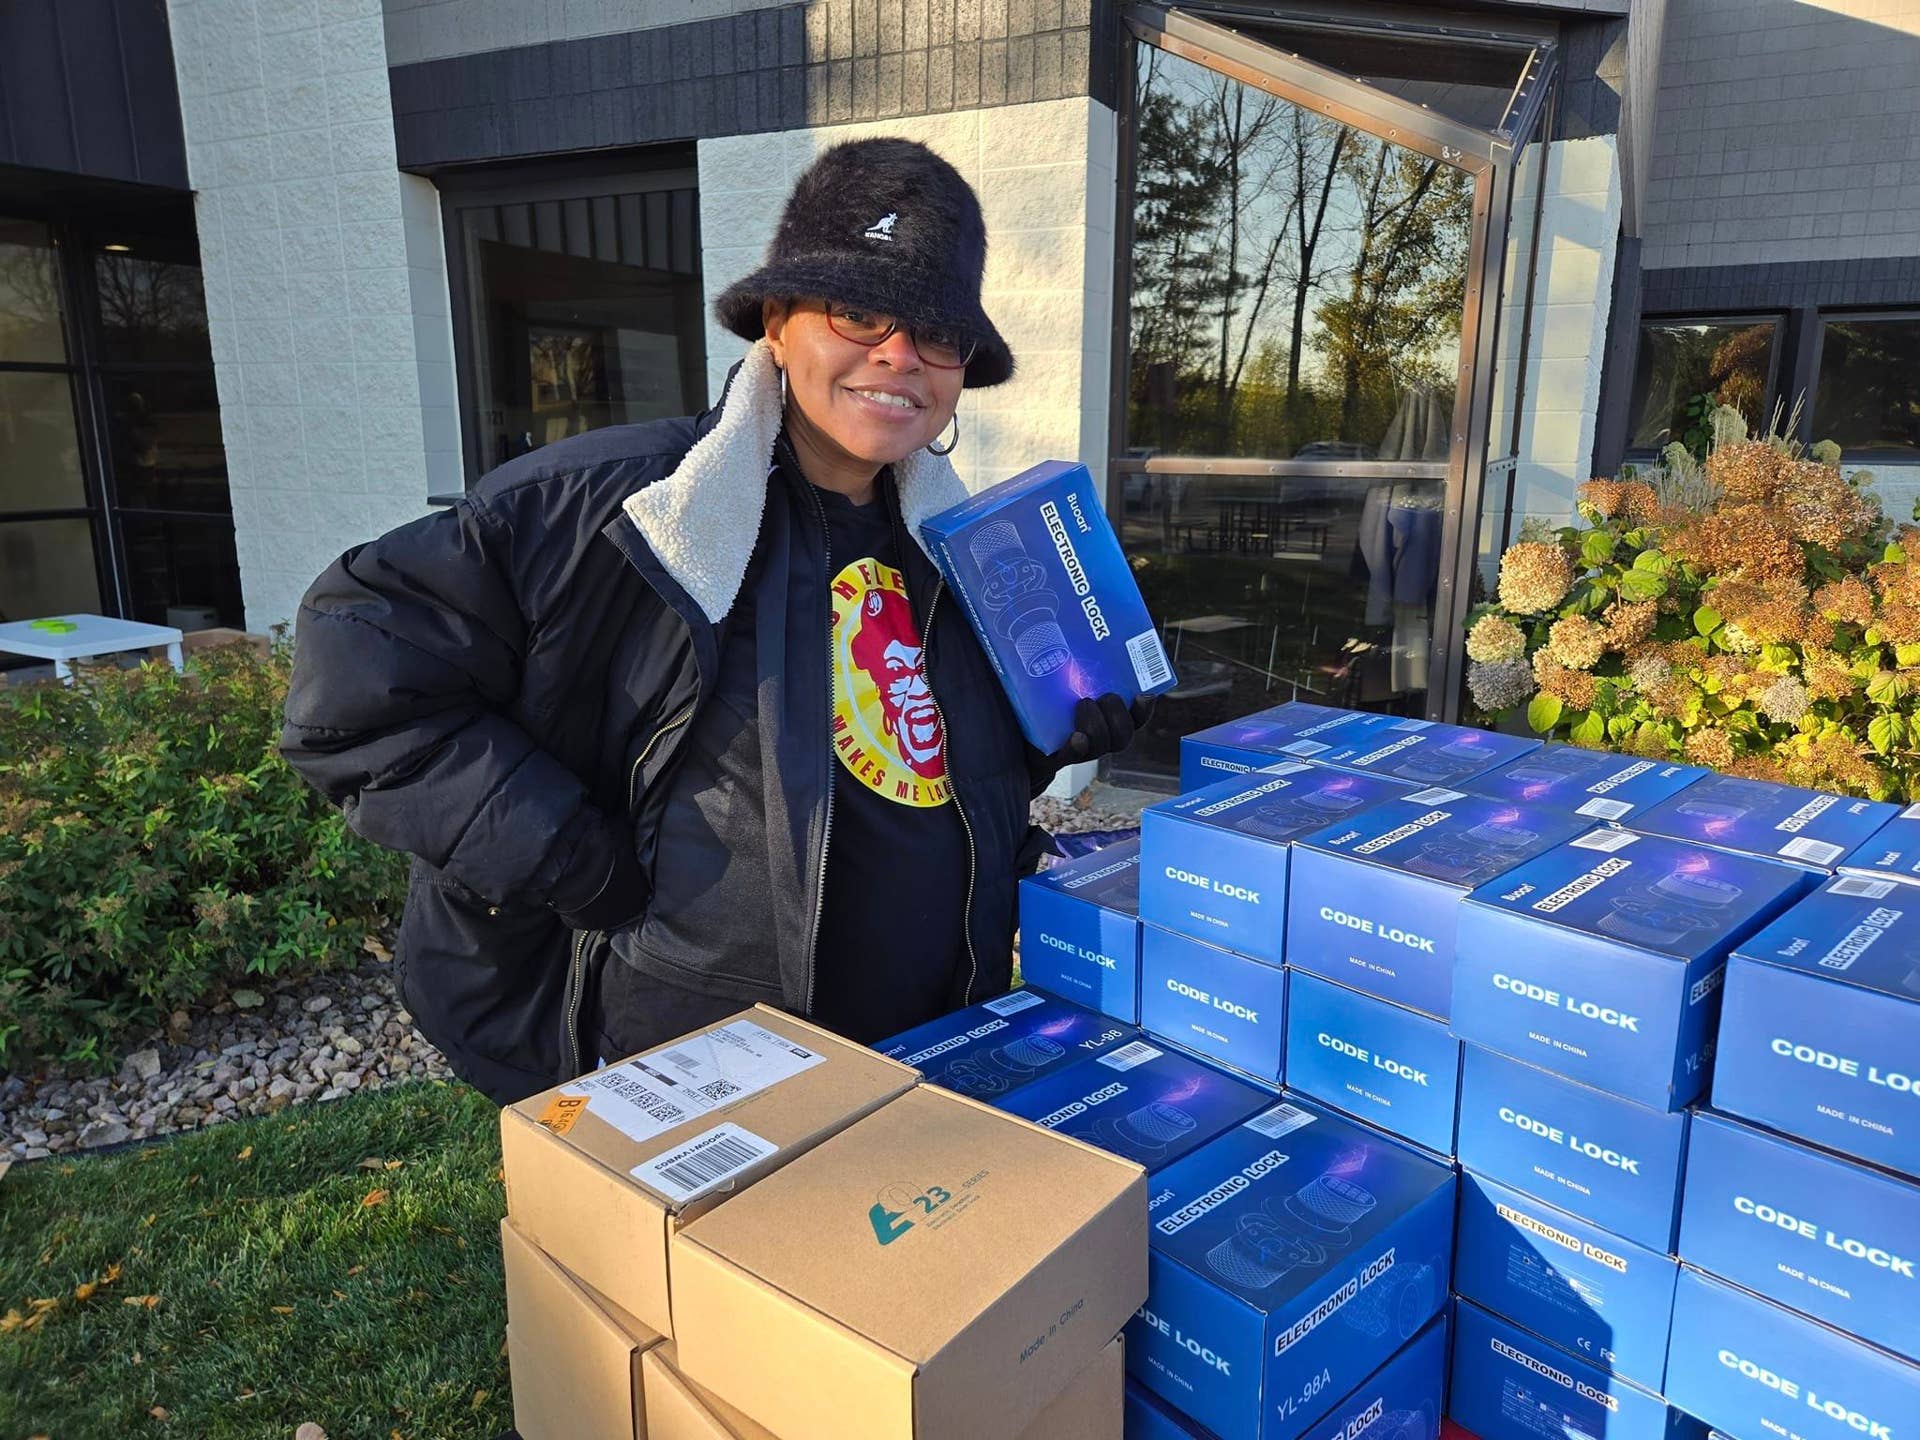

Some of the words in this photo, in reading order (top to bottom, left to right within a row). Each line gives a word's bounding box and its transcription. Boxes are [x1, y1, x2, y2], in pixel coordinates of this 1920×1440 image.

[1067, 492, 1089, 533] Buoan
[1041, 501, 1090, 595] ELECTRONIC
[1082, 597, 1109, 640] LOCK
[832, 714, 885, 787] MAKES
[896, 781, 919, 801] ME
[1202, 757, 1250, 774] ELECTRONIC
[1195, 790, 1263, 816] ELECTRONIC
[1353, 823, 1423, 854] ELECTRONIC
[1415, 811, 1451, 826] LOCK
[1165, 866, 1210, 889] CODE
[1213, 881, 1260, 904] LOCK
[1533, 874, 1605, 912] ELECTRONIC
[1592, 857, 1632, 877] LOCK
[1040, 933, 1075, 955] CODE
[1079, 947, 1117, 970] LOCK
[1320, 907, 1373, 934] CODE
[1378, 924, 1435, 953] LOCK
[1818, 925, 1883, 969] ELECTRONIC
[1862, 907, 1902, 928] LOCK
[1349, 957, 1367, 967] MADE
[1375, 965, 1396, 977] CHINA
[1166, 979, 1210, 1005] CODE
[1213, 996, 1259, 1024] LOCK
[1492, 974, 1560, 1007] CODE
[1566, 997, 1641, 1033] LOCK
[902, 1035, 970, 1066] ECTRONIC
[969, 1019, 1010, 1039] LOCK
[1078, 1028, 1122, 1051] YL-98
[1318, 1033, 1369, 1063] CODE
[1373, 1054, 1430, 1088] LOCK
[1529, 1031, 1551, 1045] MADE
[1553, 1040, 1562, 1049] IN
[1562, 1043, 1588, 1058] CHINA
[1771, 1038, 1859, 1077] CODE
[1868, 1066, 1920, 1096] LO
[1037, 1102, 1088, 1128] RONIC
[1083, 1082, 1128, 1106] LOCK
[1346, 1083, 1362, 1096] MADE
[1371, 1093, 1392, 1107] CHINA
[1499, 1107, 1563, 1144] CODE
[1569, 1136, 1640, 1176] LOCK
[1816, 1104, 1845, 1120] MADE
[1849, 1114, 1860, 1126] IN
[1861, 1119, 1895, 1135] CHINA
[913, 1186, 951, 1213] 23
[1157, 1176, 1249, 1234] ELECTRONIC
[1242, 1151, 1289, 1179] LOCK
[1534, 1165, 1554, 1180] MADE
[1566, 1178, 1591, 1195] CHINA
[1496, 1204, 1581, 1250] ELECTRONIC
[1584, 1243, 1627, 1272] LOCK
[1734, 1196, 1818, 1240] CODE
[1825, 1231, 1916, 1279] LOCK
[1275, 1279, 1357, 1355] ELECTRONIC
[1360, 1249, 1395, 1288] LOCK
[1777, 1263, 1805, 1281] MADE
[1807, 1275, 1818, 1286] IN
[1819, 1281, 1851, 1299] CHINA
[1019, 1334, 1045, 1364] Made
[1049, 1323, 1057, 1337] in
[1060, 1298, 1084, 1325] China
[1176, 1330, 1230, 1376] LOCK
[1277, 1368, 1331, 1421] YL-98A
[1491, 1338, 1573, 1388] ELECTRONIC
[1577, 1381, 1618, 1412] LOCK
[1718, 1350, 1800, 1399] CODE
[1807, 1391, 1892, 1440] LOCK
[1348, 1398, 1383, 1440] LOCK
[1761, 1417, 1787, 1437] MADE
